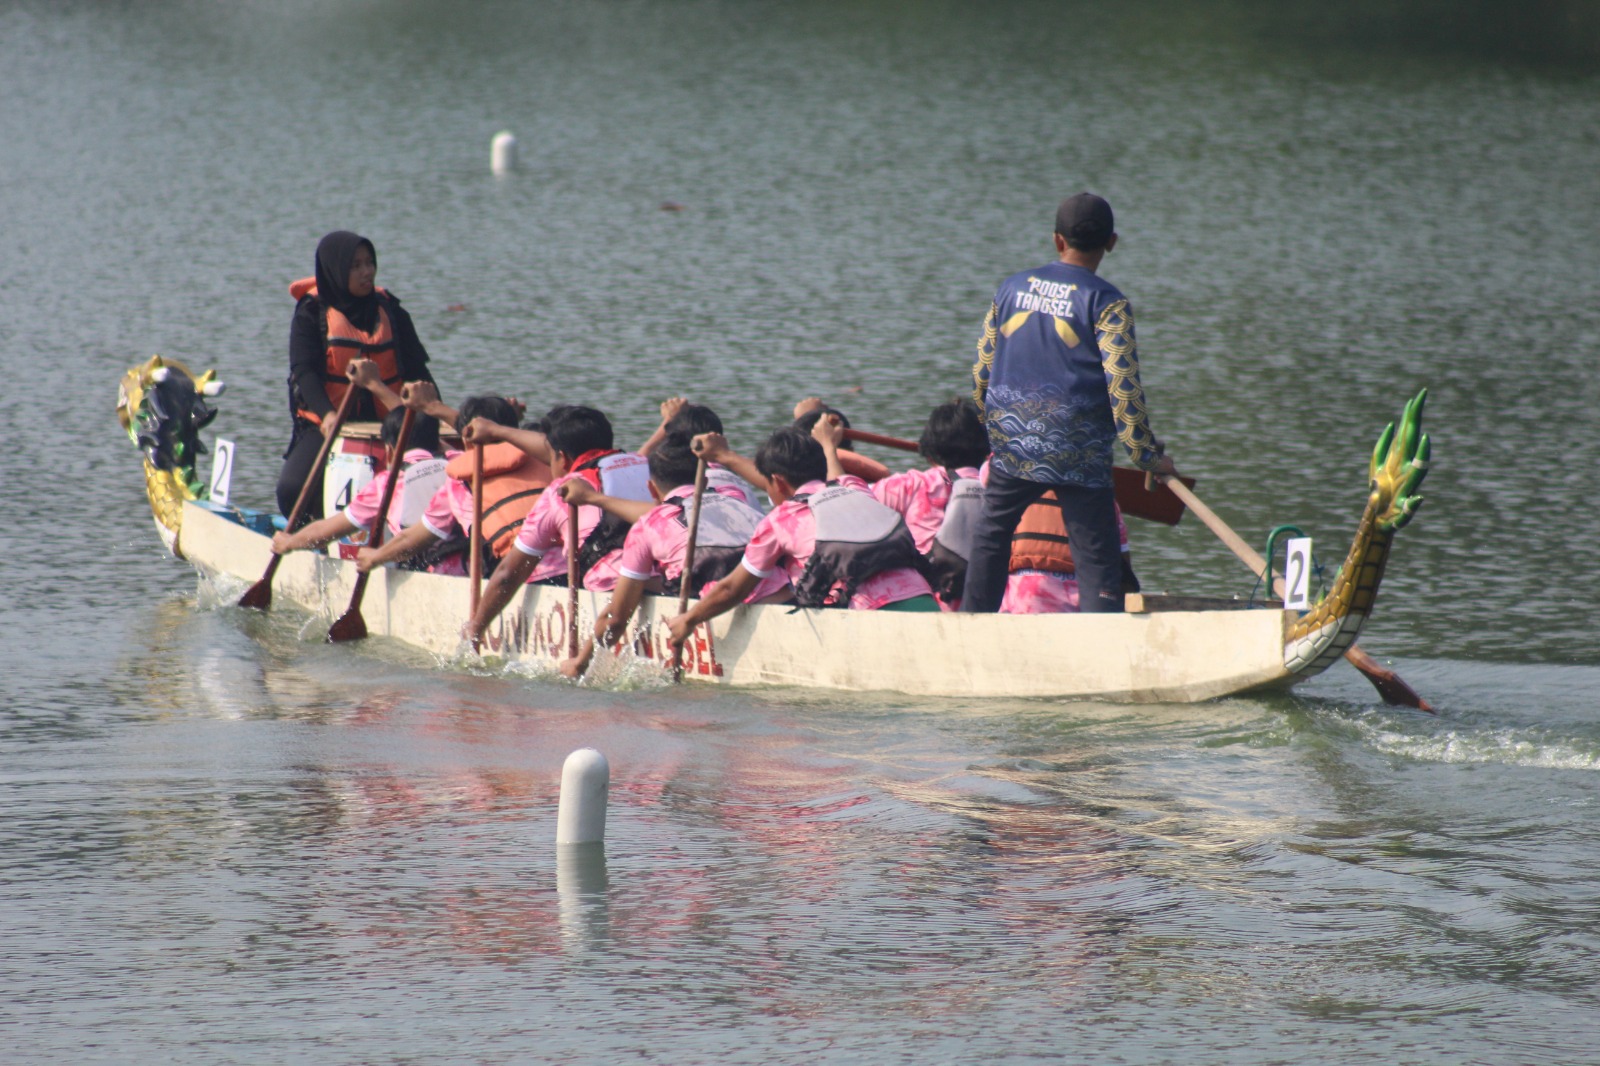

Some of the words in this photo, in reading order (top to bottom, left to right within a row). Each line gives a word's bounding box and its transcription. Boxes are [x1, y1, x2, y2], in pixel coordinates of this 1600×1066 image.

[1015, 291, 1074, 318] TANGSEL
[213, 445, 228, 497] 2
[335, 478, 353, 511] 4
[1288, 550, 1305, 604] 2
